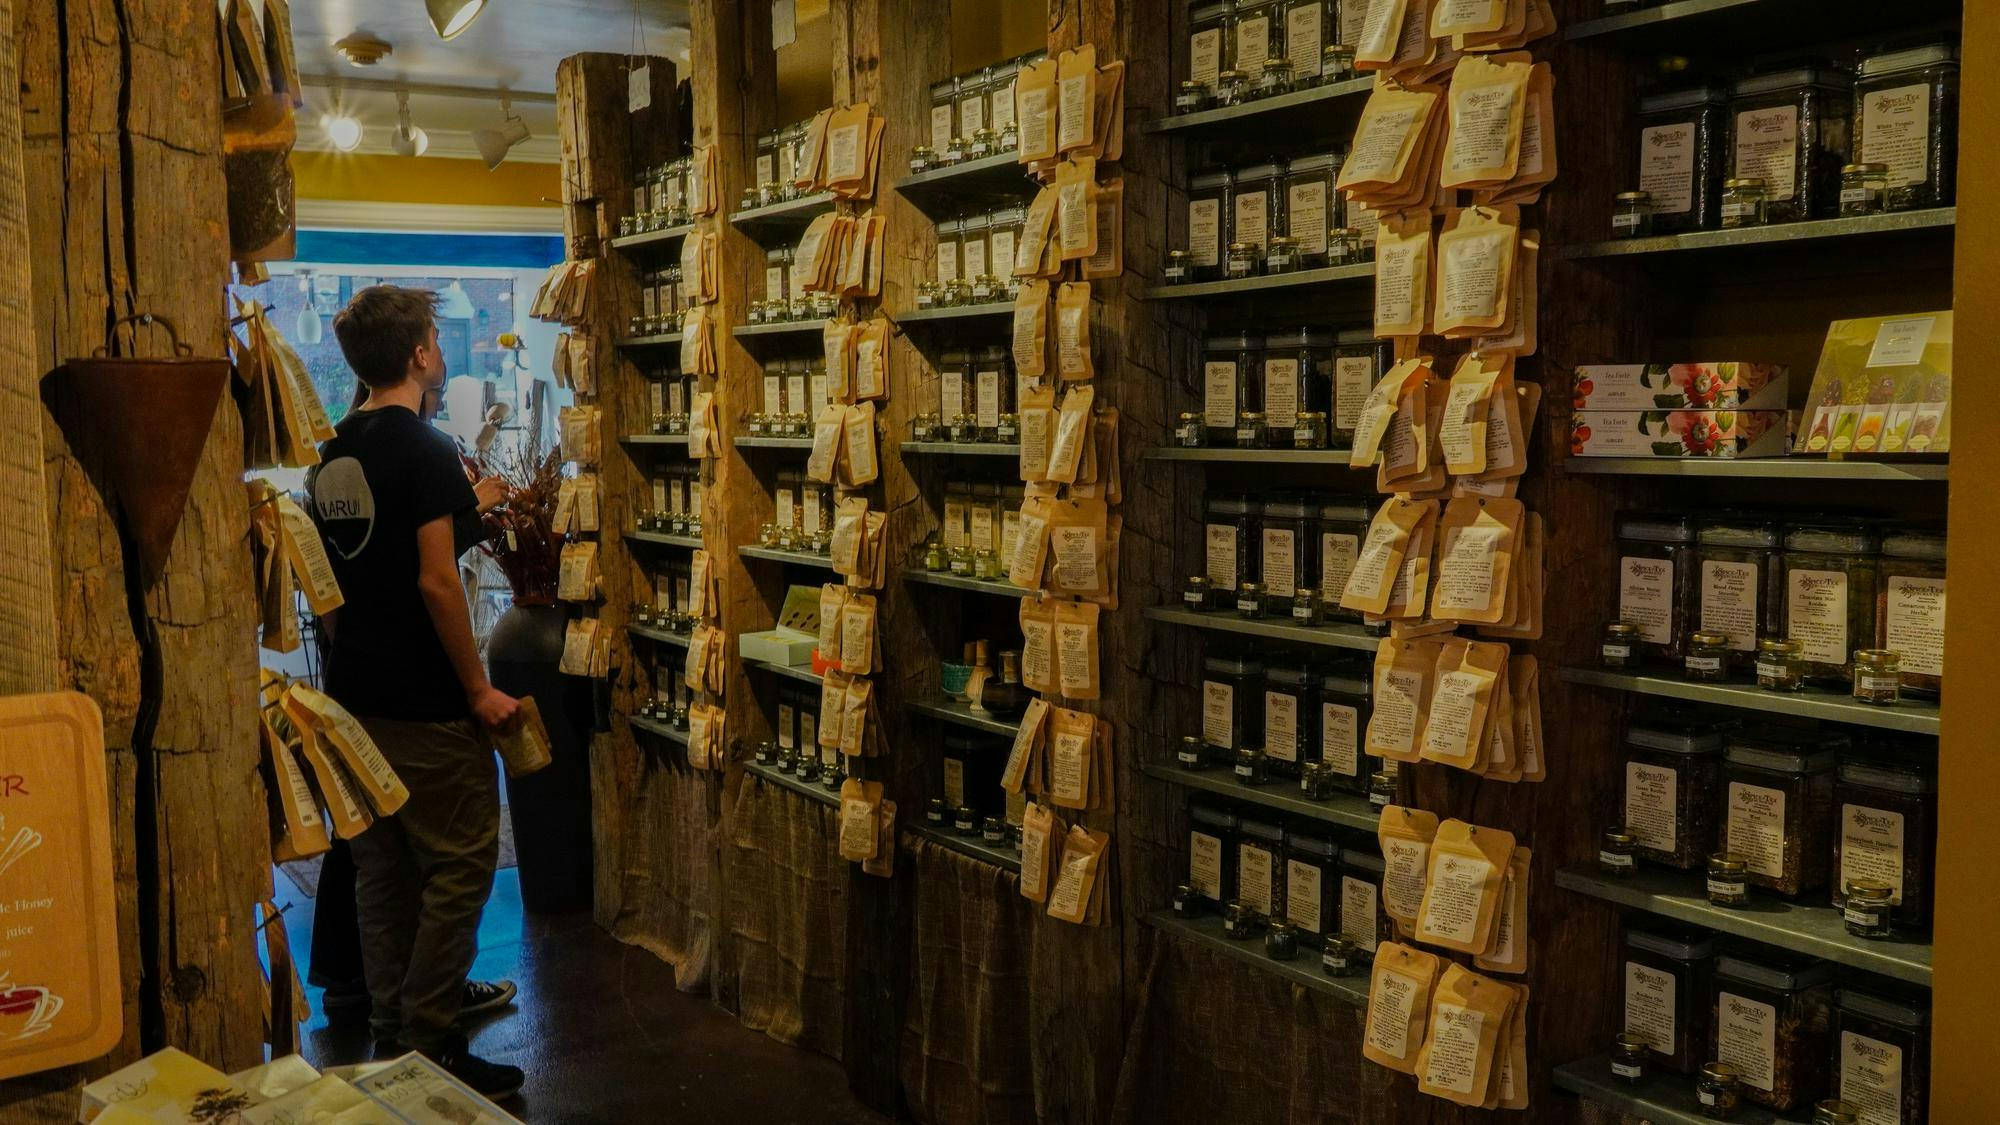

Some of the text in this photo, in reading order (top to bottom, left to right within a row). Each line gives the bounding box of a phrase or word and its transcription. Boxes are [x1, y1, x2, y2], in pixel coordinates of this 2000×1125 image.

[1897, 602, 1926, 610] Cinnamon
[1910, 609, 1929, 617] Herbal
[0, 774, 29, 797] R
[15, 897, 54, 912] Honey
[6, 924, 34, 941] juice
